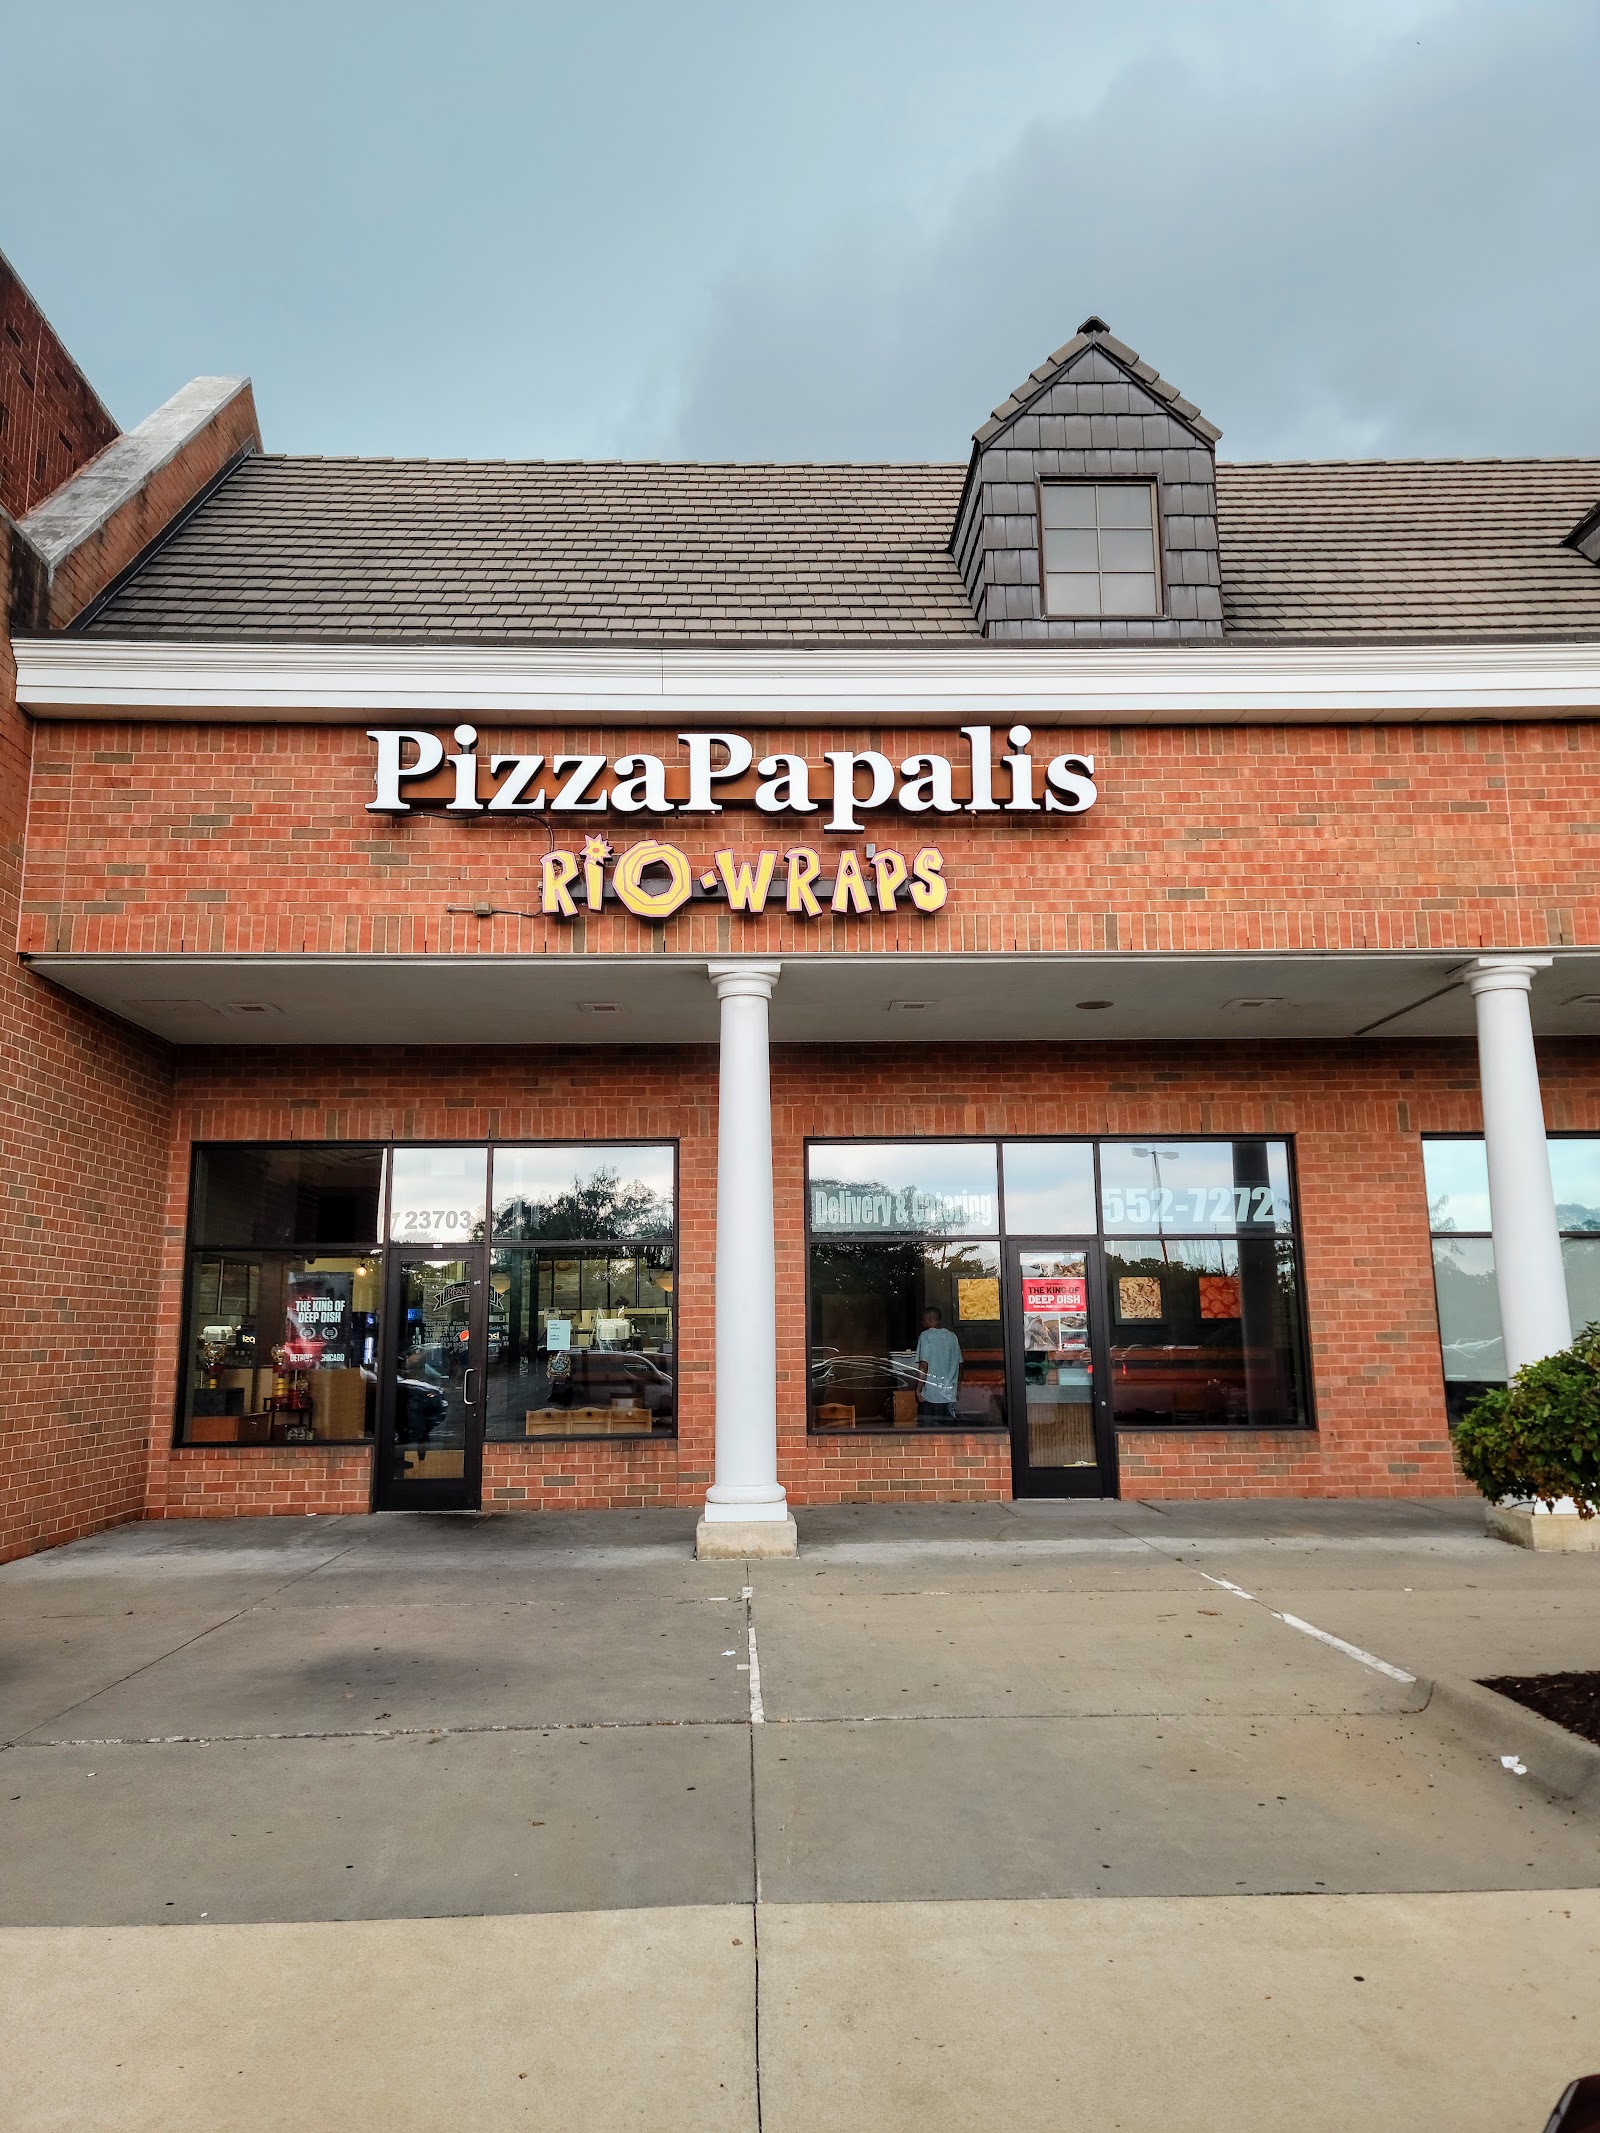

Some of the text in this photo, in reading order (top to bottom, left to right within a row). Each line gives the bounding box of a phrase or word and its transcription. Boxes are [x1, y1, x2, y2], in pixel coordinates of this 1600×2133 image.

[366, 724, 1098, 832] PizzaPapalis
[815, 1190, 992, 1227] Delivery & Catering
[1103, 1187, 1275, 1223] 552-7272
[404, 1210, 472, 1230] 23703
[1028, 1286, 1080, 1294] THE KING OF
[295, 1300, 346, 1312] THE KING OF
[1028, 1295, 1081, 1304] DEEP DISH
[298, 1312, 342, 1323] DEEP DISH
